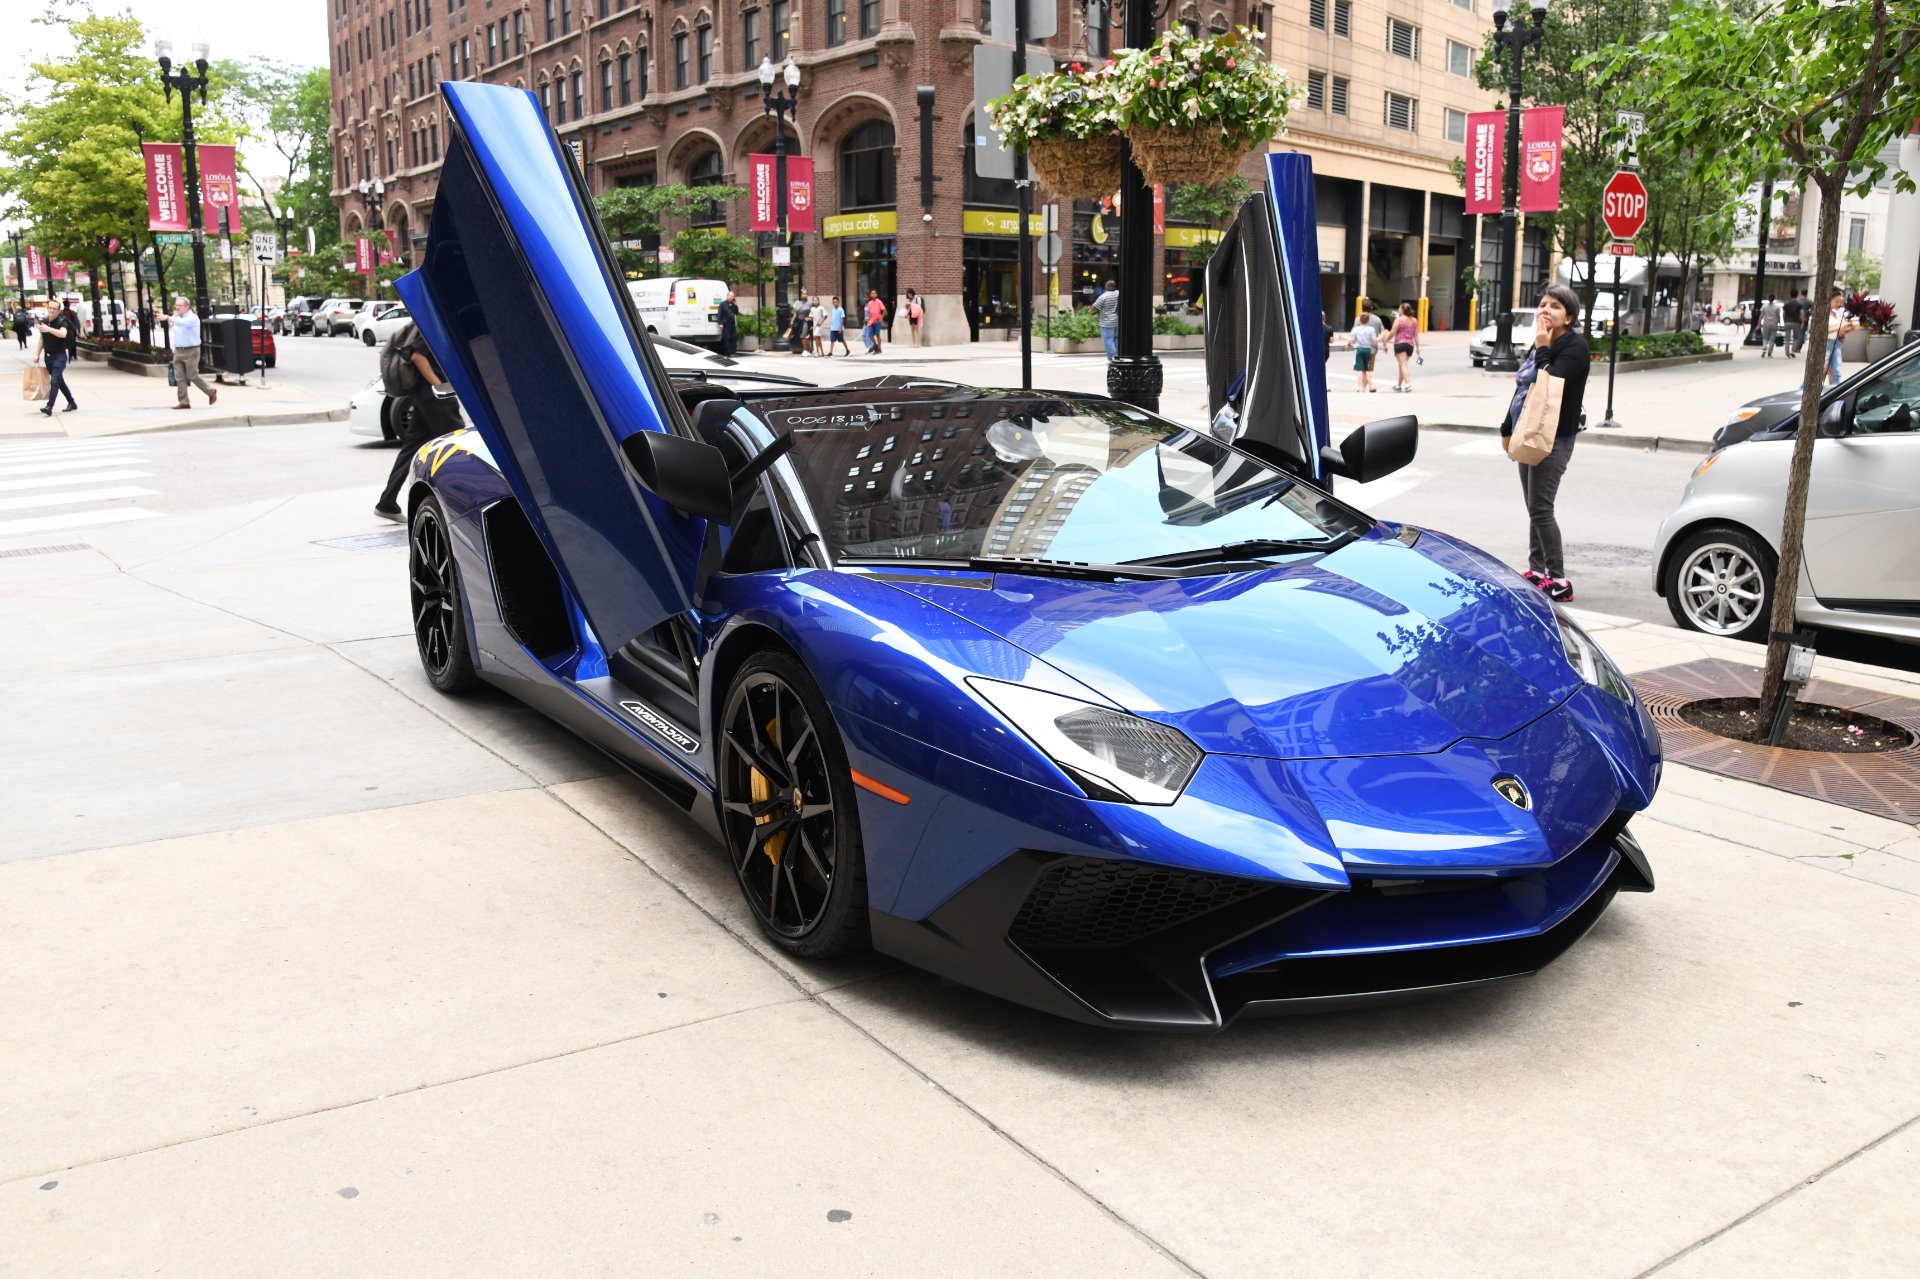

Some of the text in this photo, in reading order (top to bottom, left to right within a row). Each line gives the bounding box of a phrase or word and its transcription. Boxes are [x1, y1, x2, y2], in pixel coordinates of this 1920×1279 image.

[1527, 141, 1556, 150] LOYOLA
[1475, 124, 1488, 201] WELCOME
[154, 153, 171, 222] WELCOME
[205, 173, 232, 181] LOYOLA
[757, 163, 766, 222] WELCOME
[1605, 192, 1644, 218] STOP
[829, 213, 879, 235] argo tea café
[255, 236, 273, 244] ONE
[255, 244, 274, 253] WAY
[1612, 245, 1633, 255] ALL WAY
[630, 706, 691, 745] AVENTADOR
